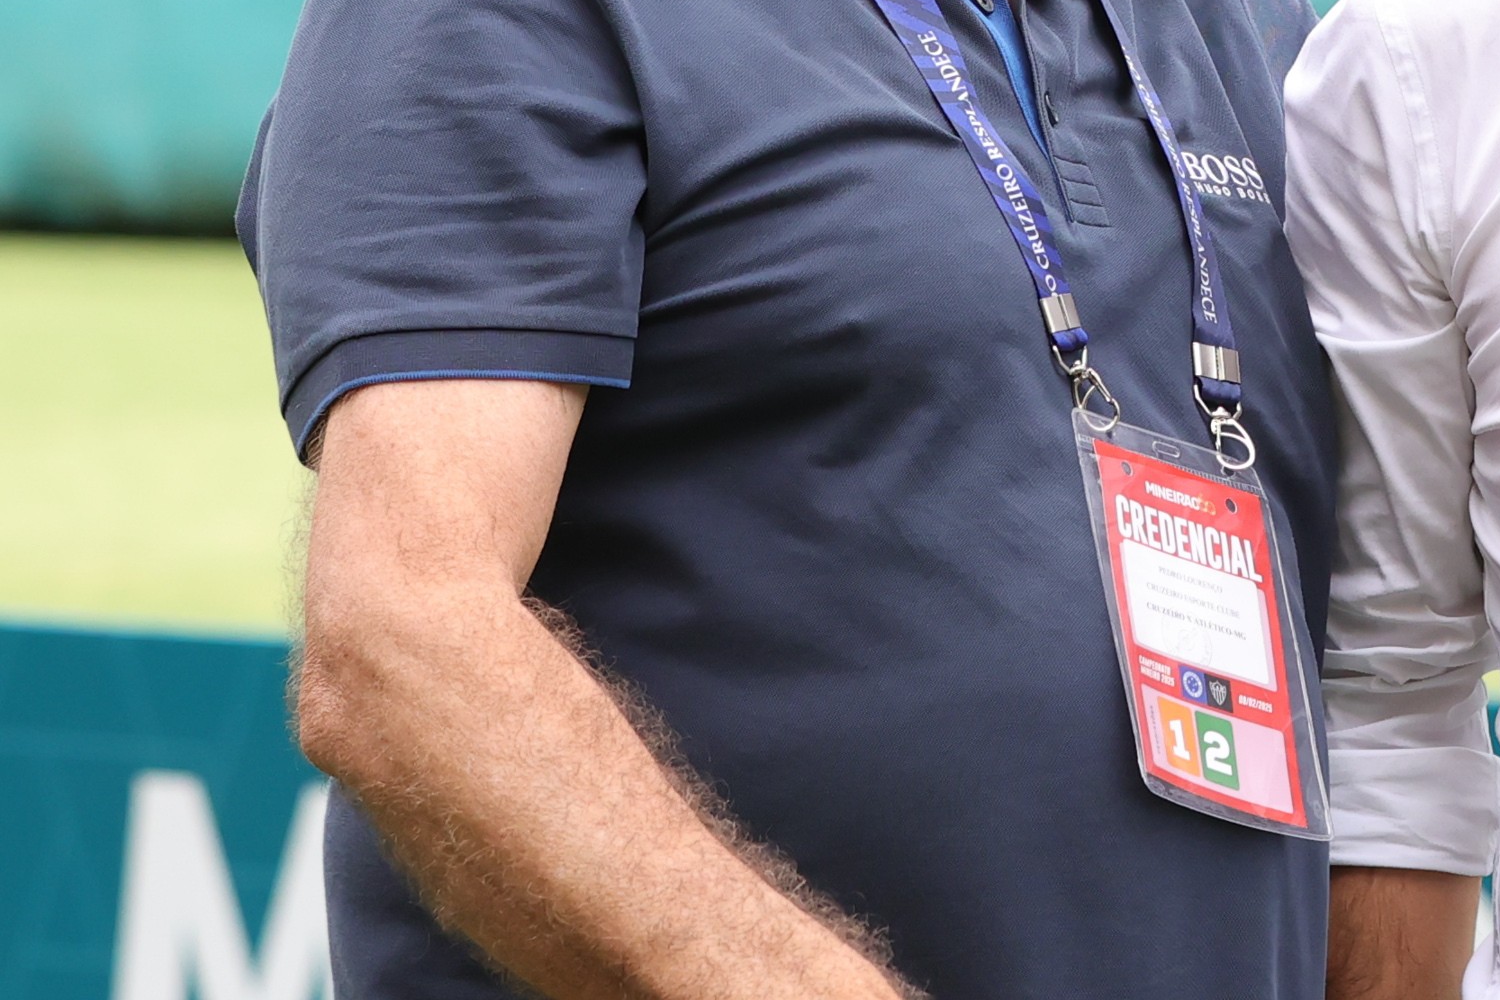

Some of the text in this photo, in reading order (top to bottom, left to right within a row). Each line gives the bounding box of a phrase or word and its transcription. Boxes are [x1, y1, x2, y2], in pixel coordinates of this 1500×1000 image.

[918, 30, 1003, 160] RESPLANDECE
[1180, 151, 1264, 190] BOSS
[1193, 181, 1232, 198] HUGO
[995, 163, 1050, 270] CRUZEIRO
[1181, 181, 1218, 324] RESPLANDECE
[1115, 494, 1263, 583] CREDENCIAL
[1146, 601, 1185, 621] CRUZEIRO
[1168, 719, 1191, 761] 1
[1203, 730, 1233, 776] 2
